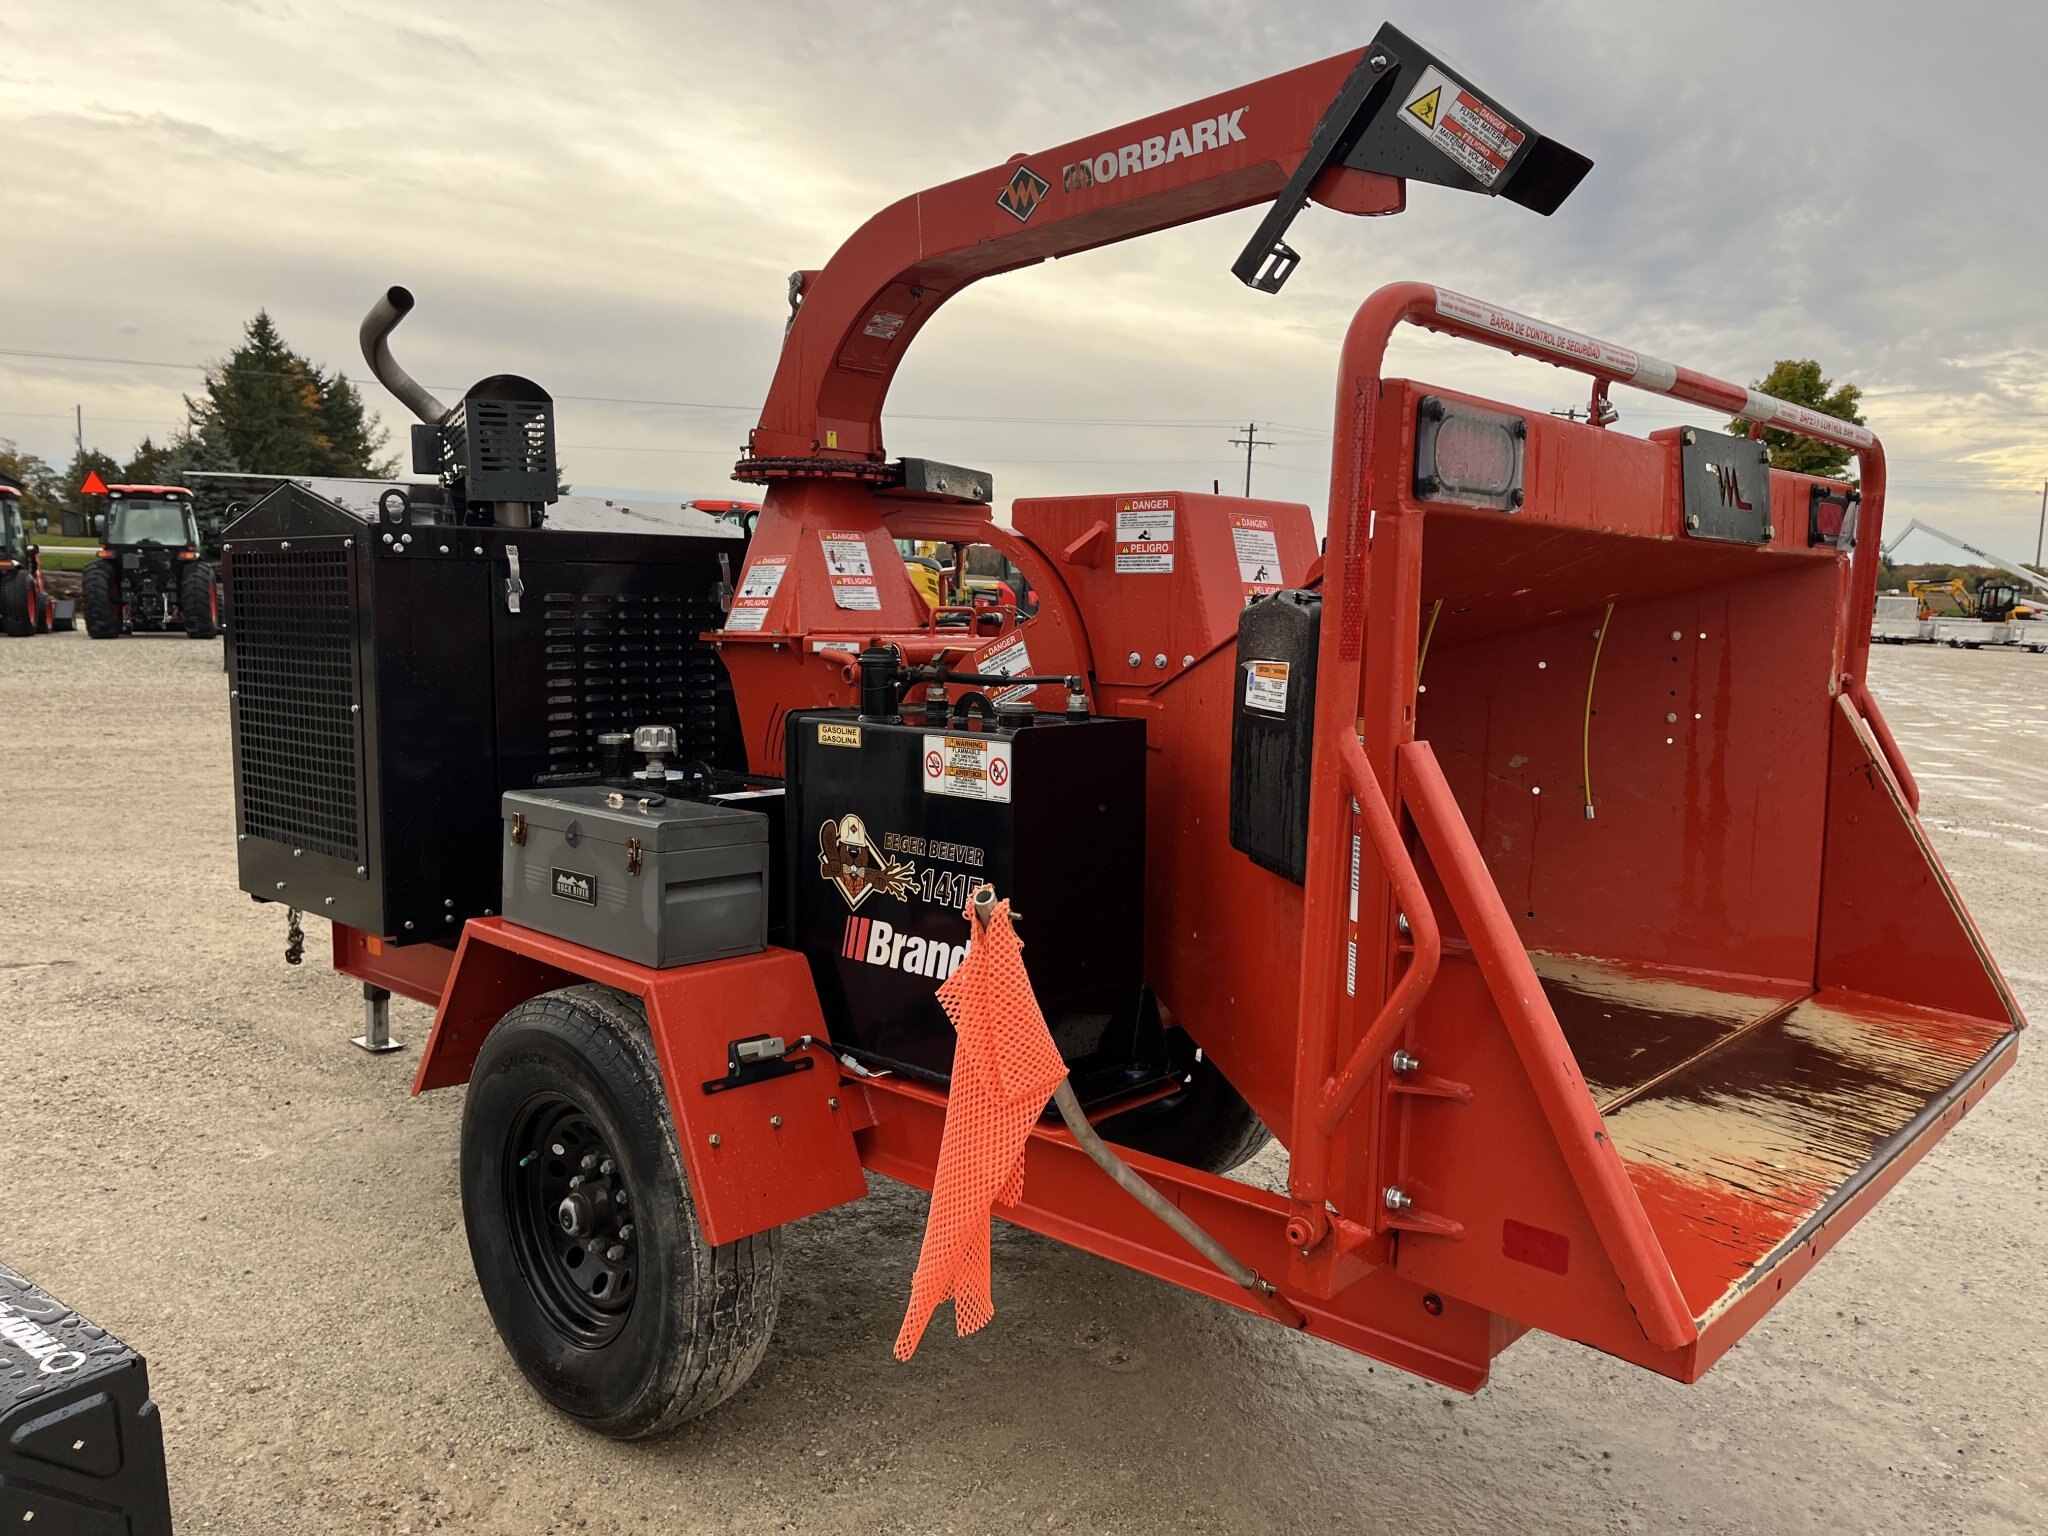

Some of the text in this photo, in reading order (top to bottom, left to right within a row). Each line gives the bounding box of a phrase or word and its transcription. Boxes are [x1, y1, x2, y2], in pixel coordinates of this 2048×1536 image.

[1480, 108, 1507, 131] DANGER
[1460, 106, 1480, 125] FLYING
[1480, 122, 1509, 147] MATERIAL
[1439, 127, 1466, 153] MATERIAL
[1468, 149, 1498, 175] VOLANDO
[1490, 313, 1514, 332] BARRA
[1515, 322, 1525, 336] DE
[1526, 326, 1556, 345] CONTROL
[1557, 336, 1566, 348] DE
[1566, 339, 1601, 359] SEGURIDAD
[1132, 499, 1169, 509] DANGER
[1241, 518, 1268, 528] DANGER
[832, 532, 860, 541] DANGER
[1130, 543, 1169, 553] PELIGRO
[761, 557, 786, 565] DANGER
[843, 577, 872, 585] PELIGRO
[743, 599, 769, 607] PELIGRO
[988, 635, 1016, 656] DANGER
[821, 725, 857, 736] GASOLINE
[821, 734, 857, 745] GASOLINA
[955, 740, 983, 749] WARNING
[952, 747, 981, 756] FLAMMABLE
[955, 769, 982, 778] ADVERTENCIA
[884, 832, 985, 867] EEGER BEEVER
